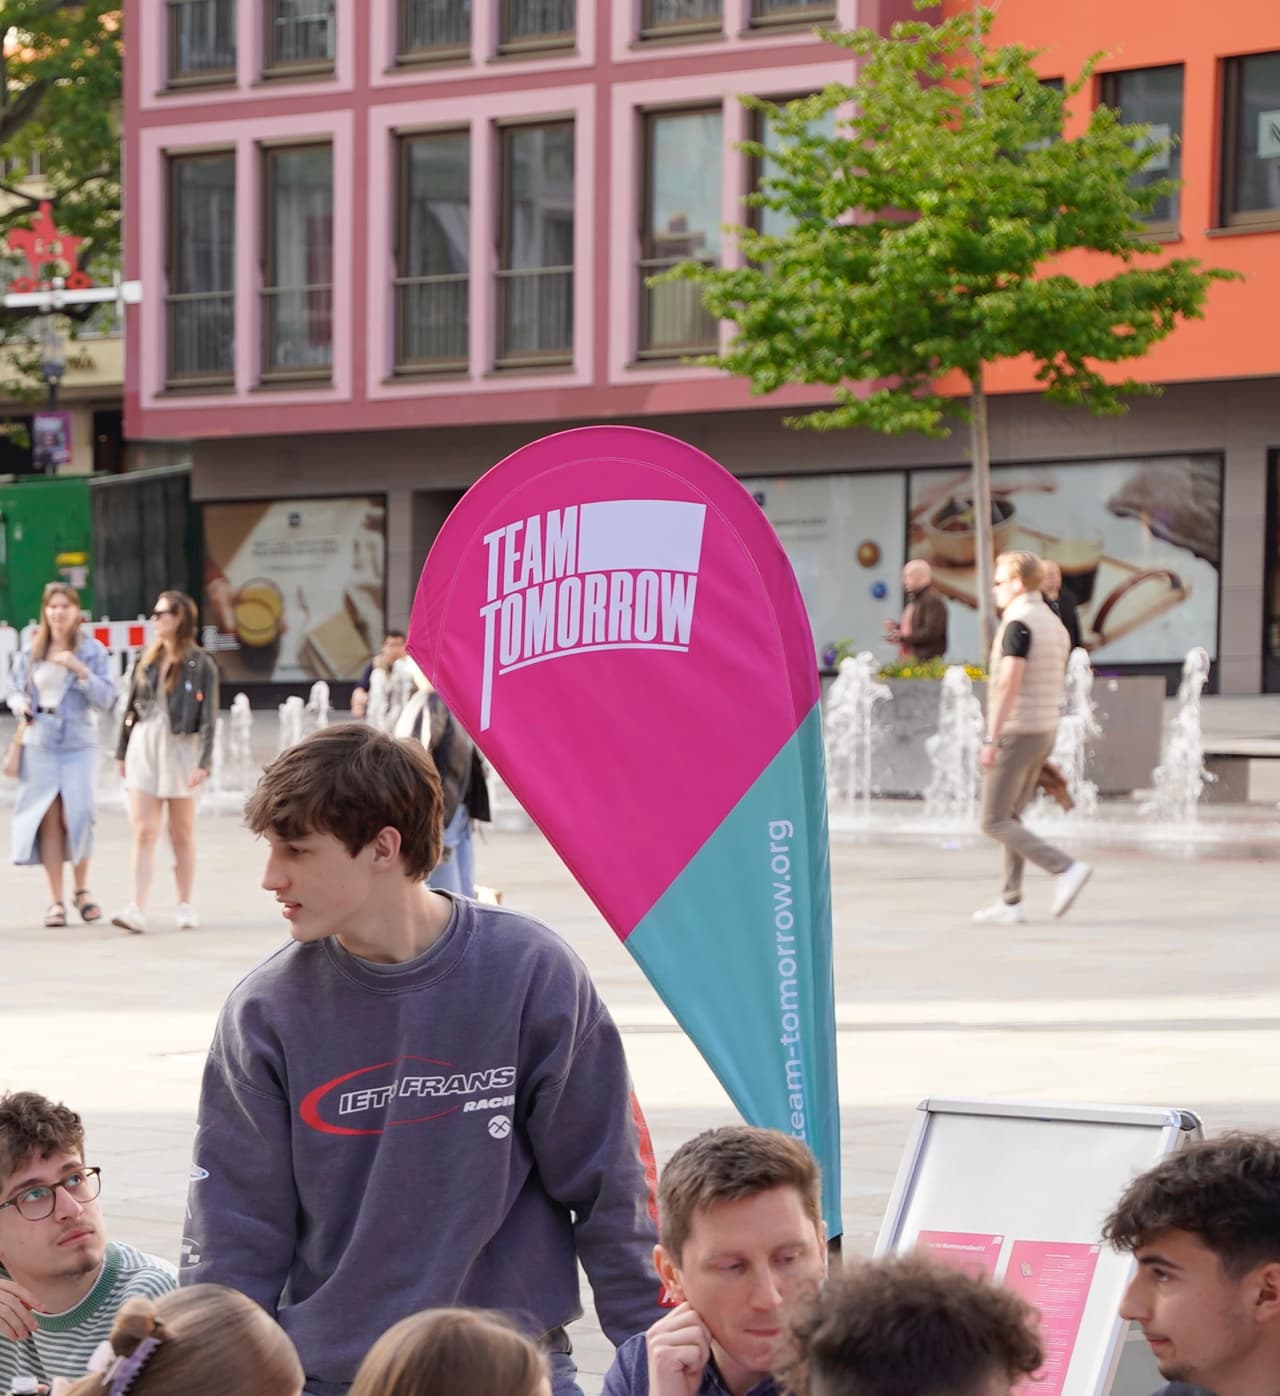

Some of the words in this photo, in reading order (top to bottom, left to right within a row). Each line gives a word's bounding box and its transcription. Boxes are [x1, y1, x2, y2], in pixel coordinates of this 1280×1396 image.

[483, 504, 579, 602] TEAM
[479, 570, 698, 732] TOMORROW
[398, 1066, 517, 1097] FRANS
